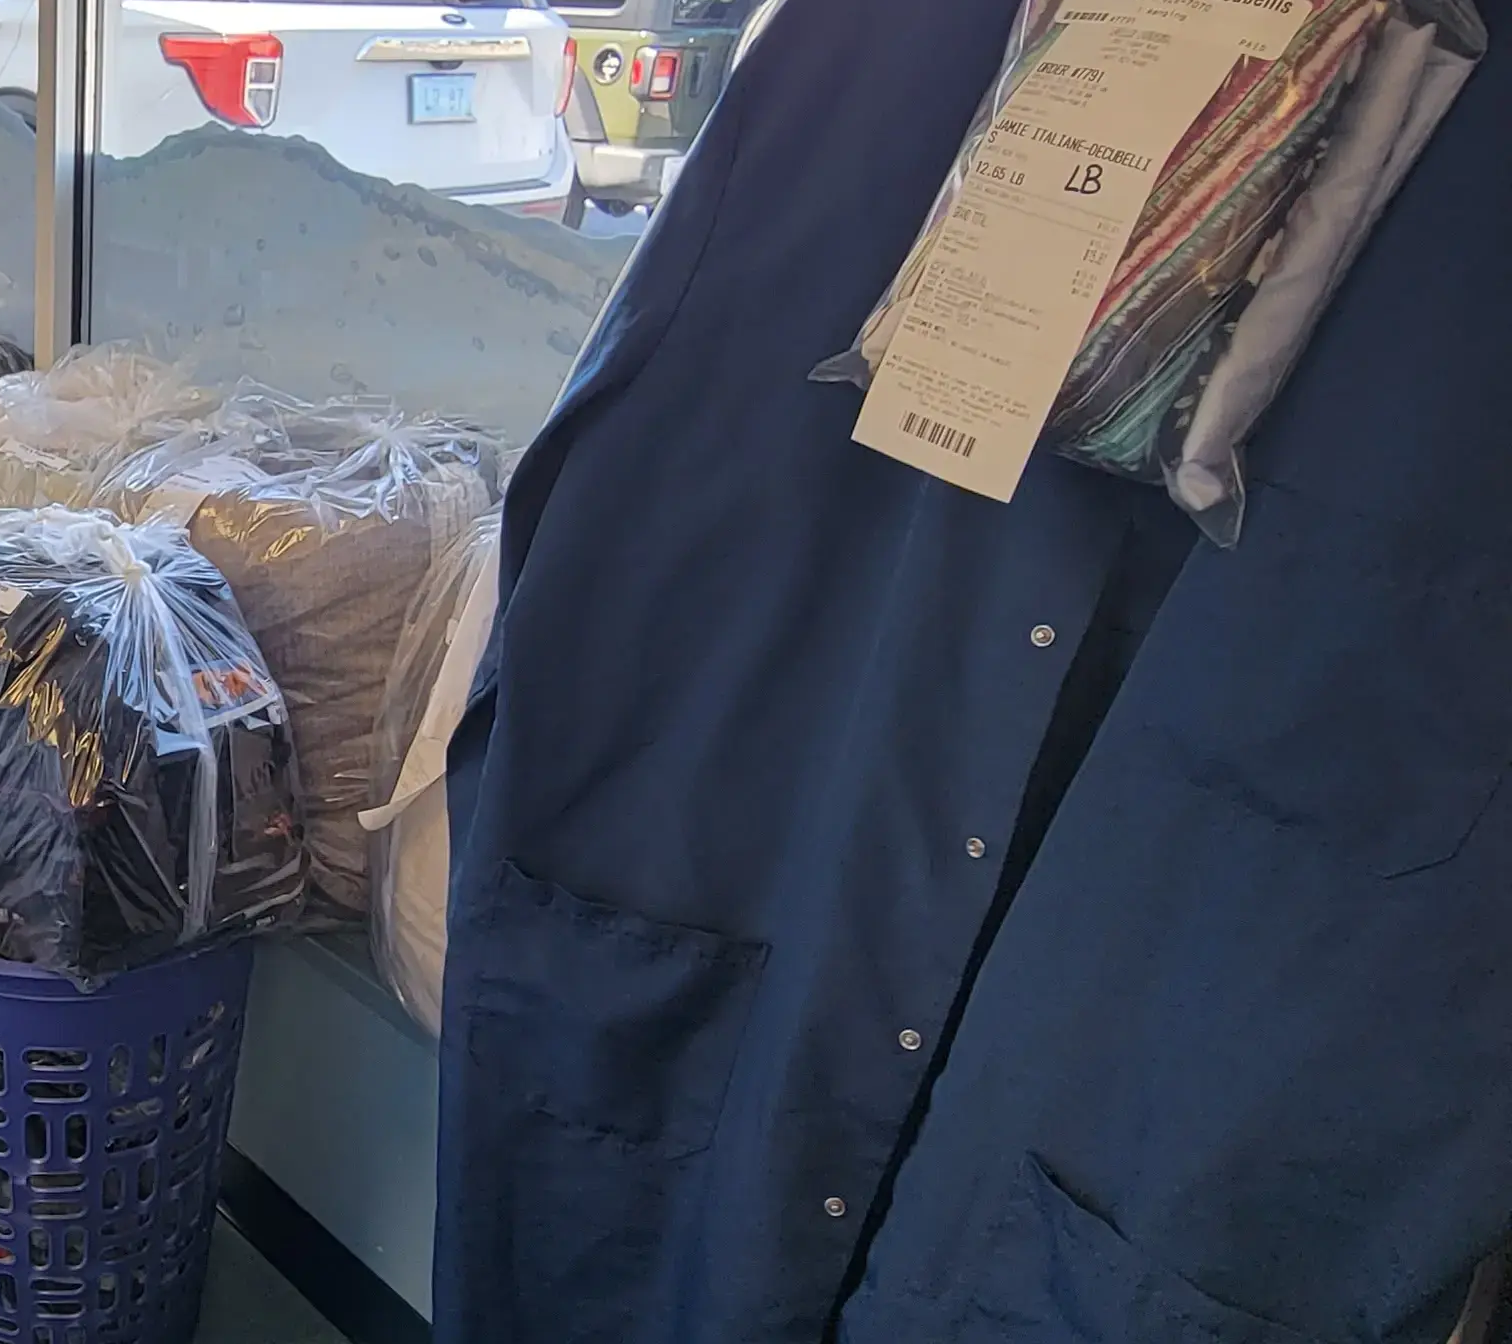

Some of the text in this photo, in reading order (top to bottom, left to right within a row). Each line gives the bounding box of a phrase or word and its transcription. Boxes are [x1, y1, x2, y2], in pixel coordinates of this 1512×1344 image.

[1037, 61, 1106, 84] ORDER #7791
[987, 130, 999, 144] S
[994, 118, 1028, 137] JAMIE
[1031, 127, 1154, 173] ITALIANE-DECUBELLI
[975, 160, 1026, 186] 12.65 LB
[1063, 163, 1104, 195] LB
